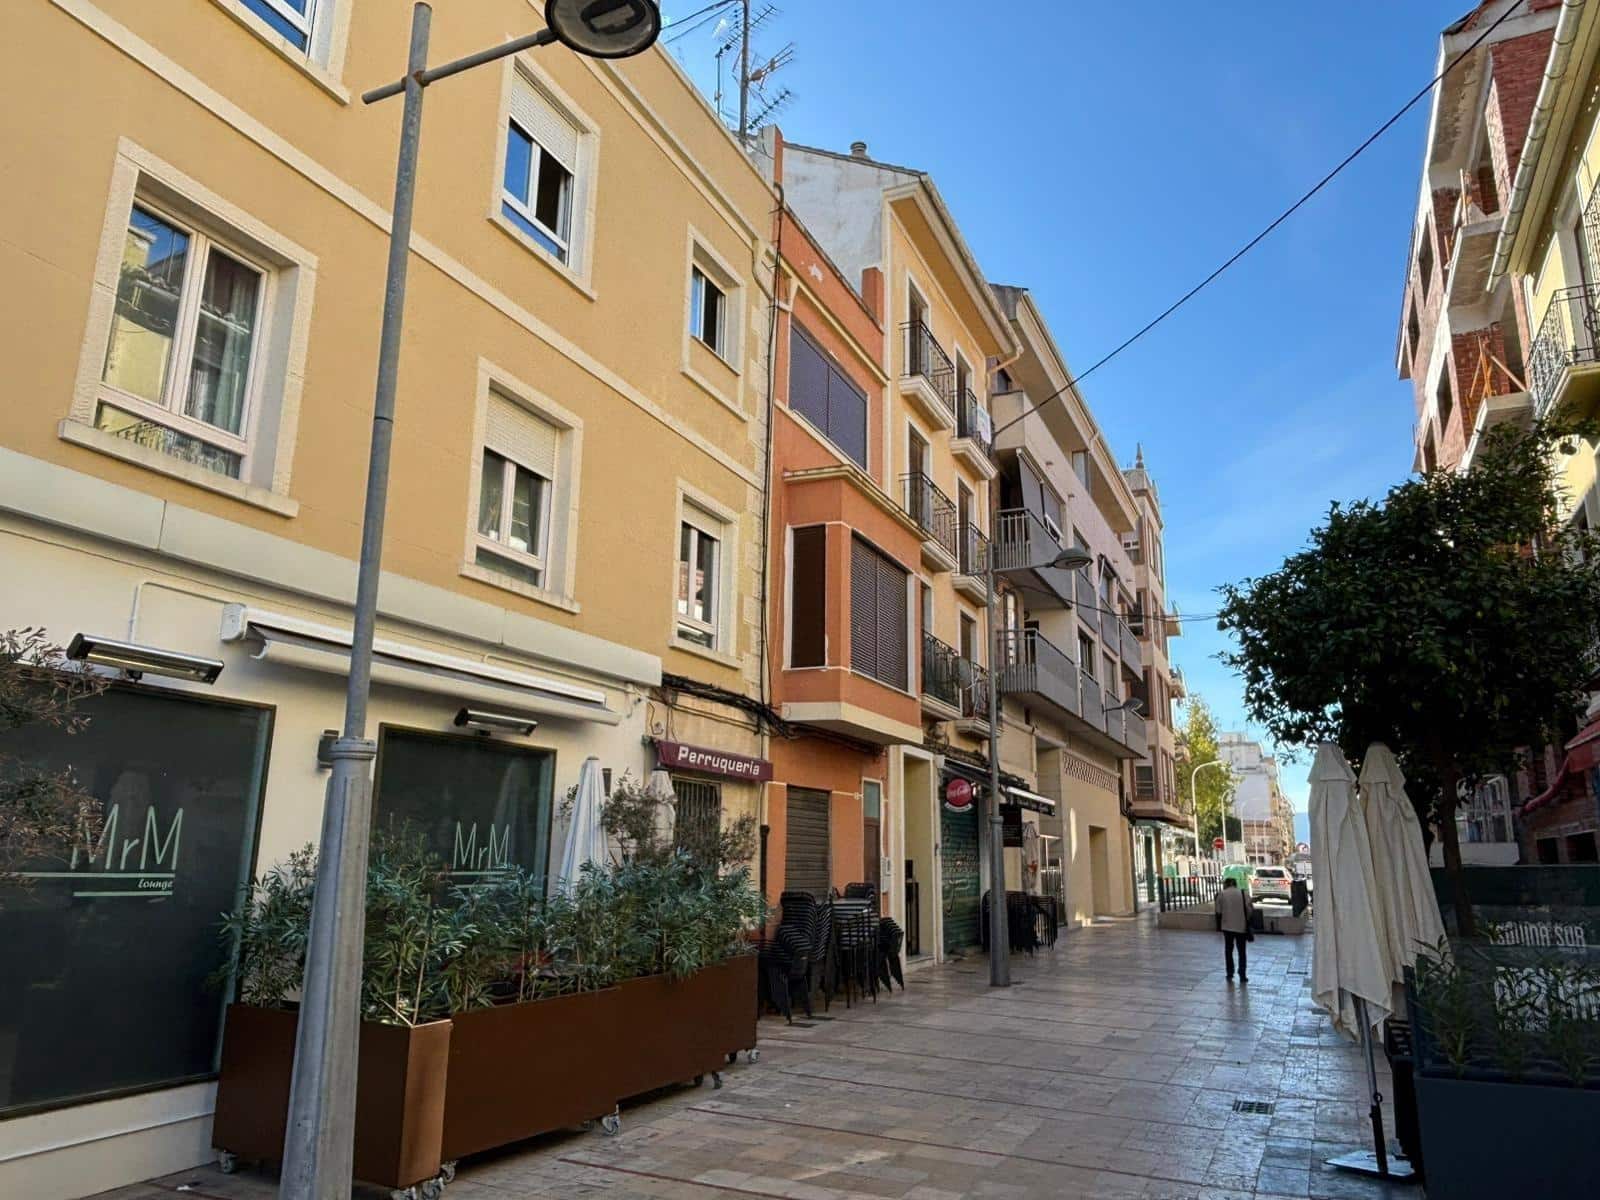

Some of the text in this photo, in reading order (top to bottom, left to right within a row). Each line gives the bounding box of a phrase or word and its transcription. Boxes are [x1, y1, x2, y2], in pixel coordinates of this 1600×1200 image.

[677, 745, 760, 776] Perruqueria
[69, 803, 184, 870] MrM
[452, 820, 510, 870] MrM
